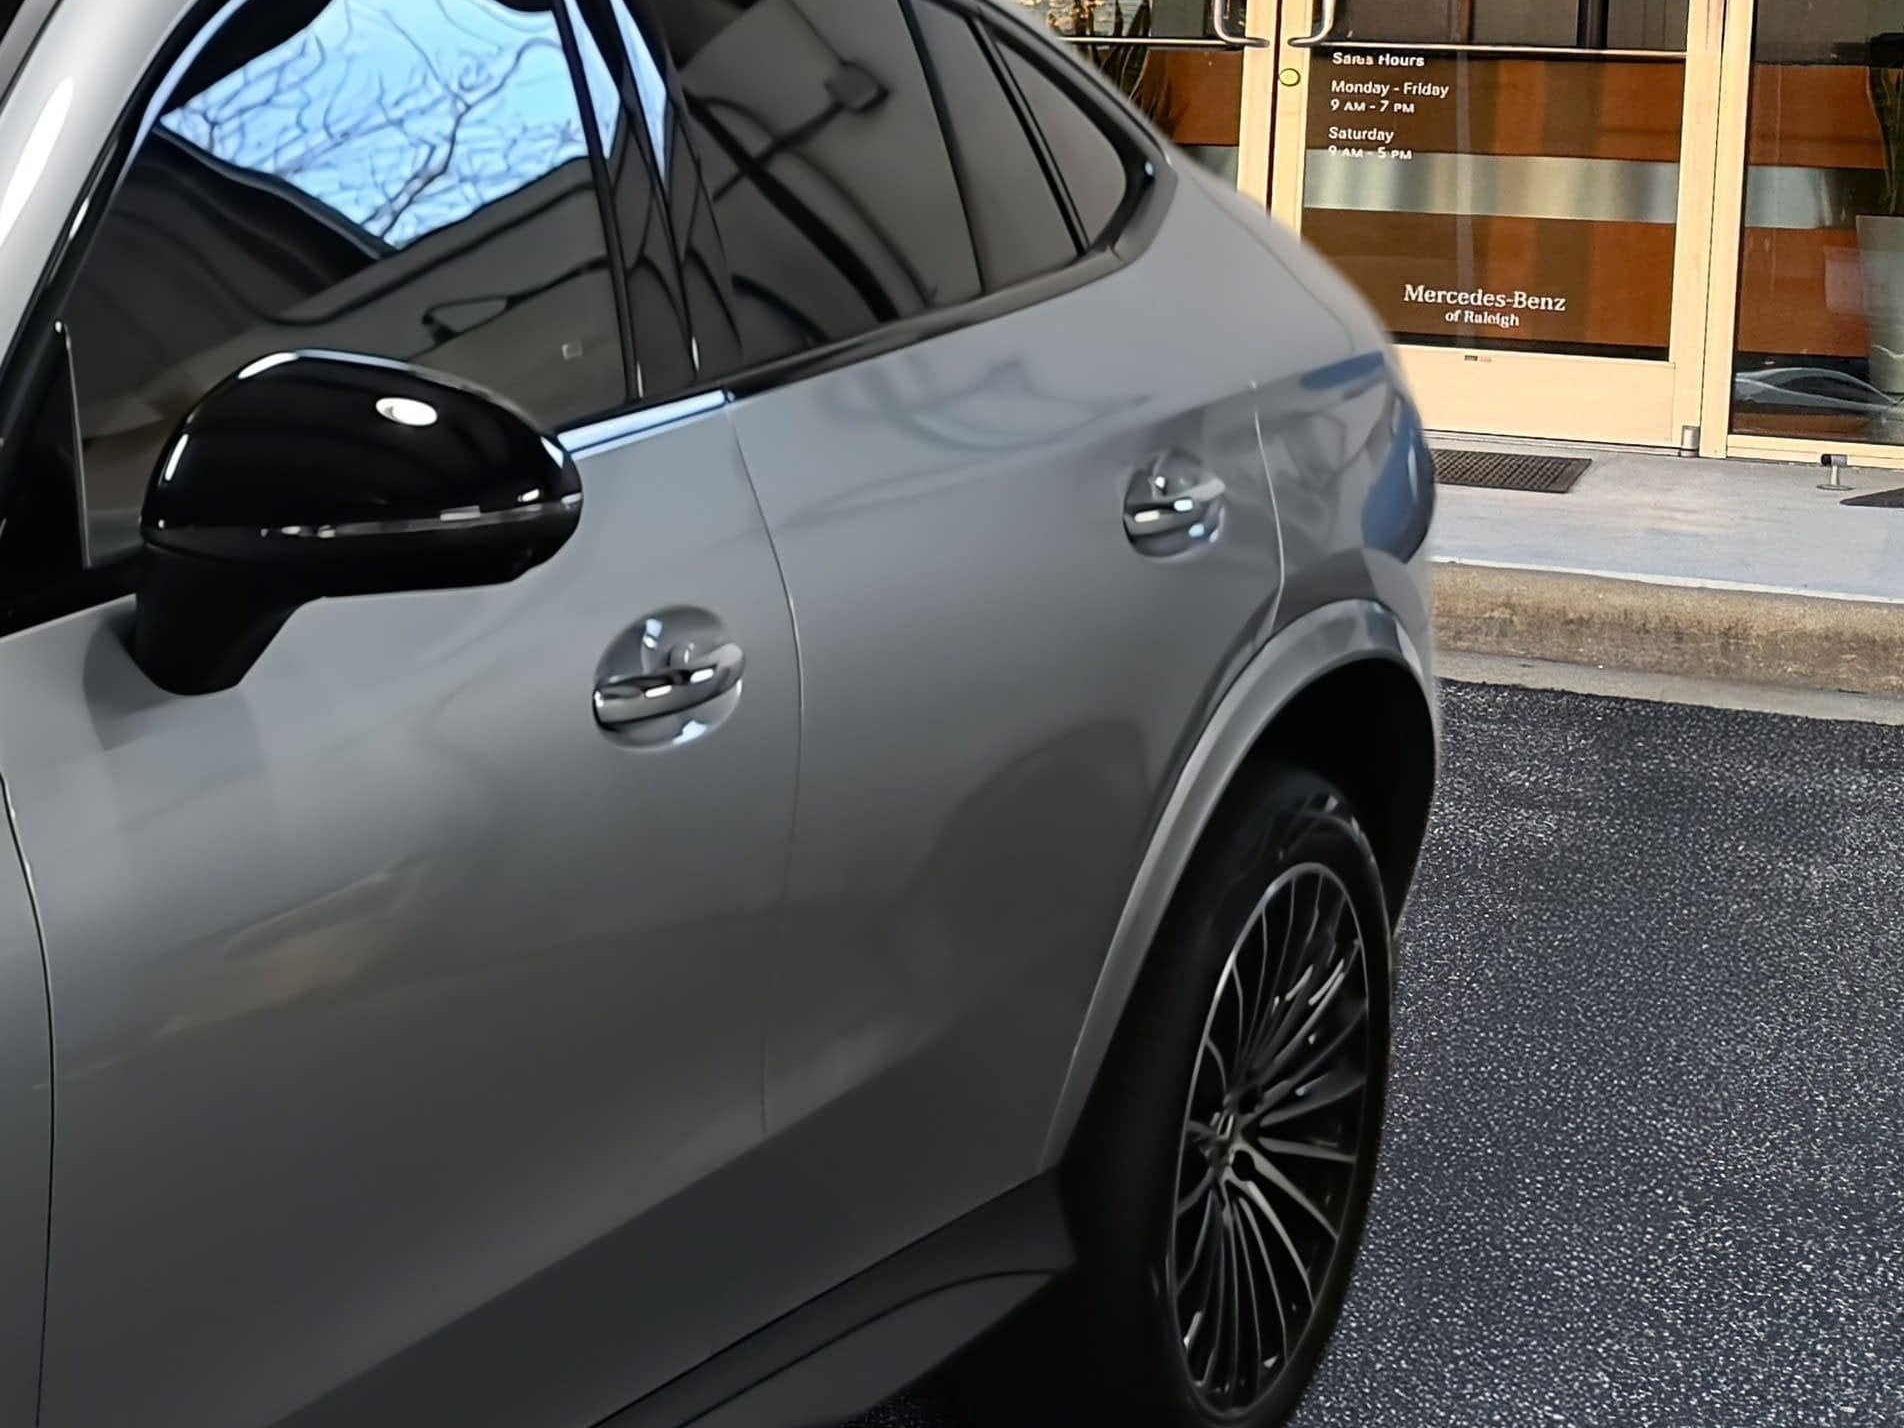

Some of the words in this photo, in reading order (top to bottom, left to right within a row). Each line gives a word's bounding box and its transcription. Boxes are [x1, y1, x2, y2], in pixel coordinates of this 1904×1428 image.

[1378, 53, 1425, 66] Hours
[1331, 80, 1390, 97] Monday
[1403, 82, 1449, 98] Friday
[1330, 99, 1340, 111] 9
[1344, 101, 1366, 111] AM
[1379, 100, 1389, 112] 7
[1393, 103, 1415, 113] PM
[1328, 127, 1394, 143] Saturday
[1328, 145, 1337, 157] 9
[1342, 148, 1363, 158] AM
[1377, 147, 1387, 158] 5
[1391, 149, 1412, 159] PM
[1403, 284, 1566, 312] Mercedes-Benz
[1445, 309, 1460, 322] of
[1464, 311, 1520, 328] Raleigh
